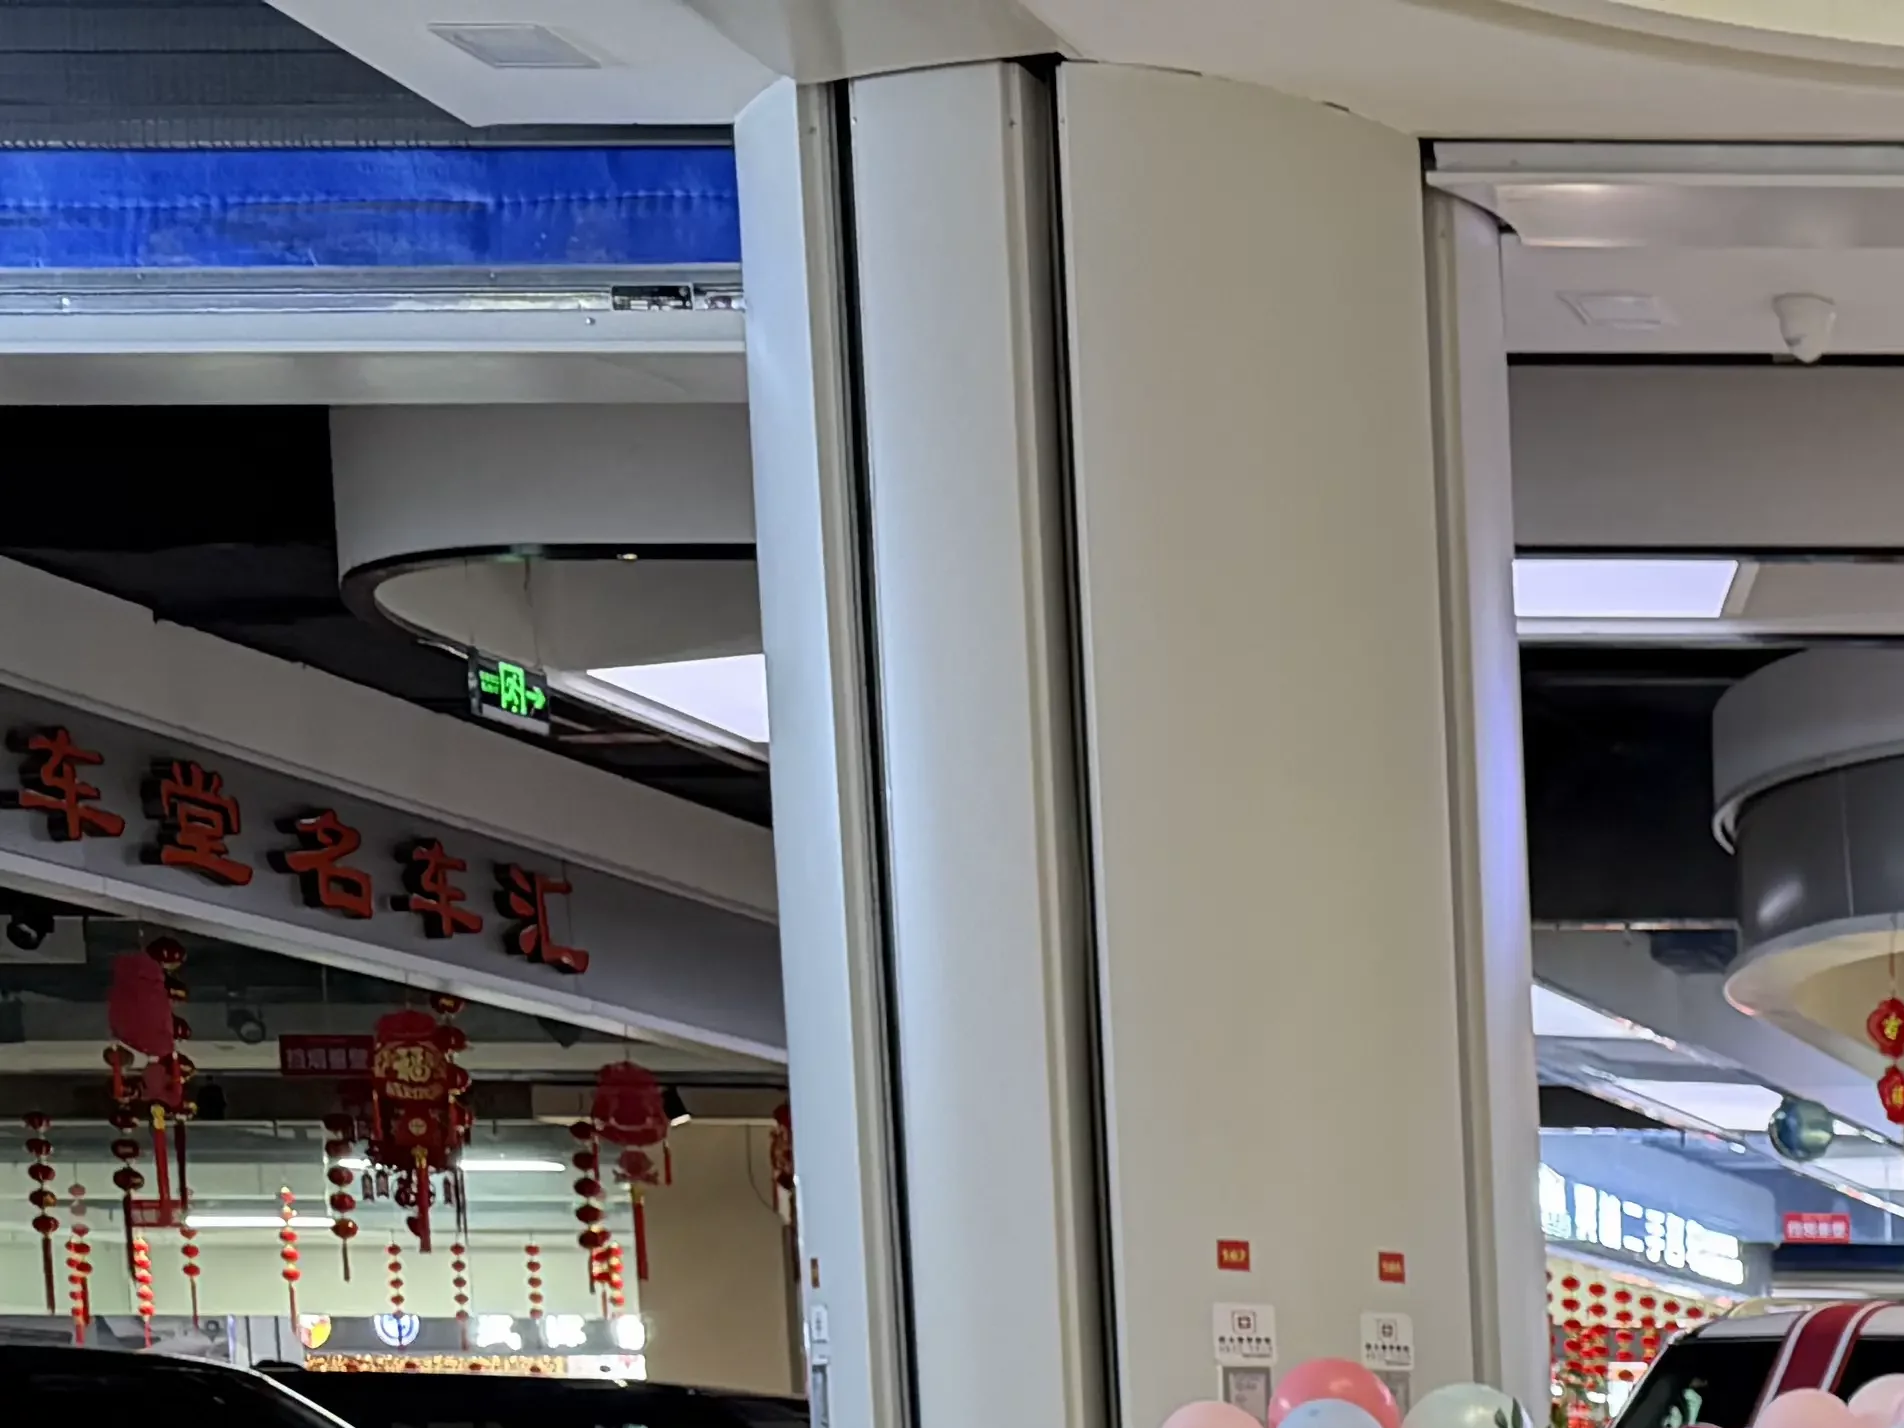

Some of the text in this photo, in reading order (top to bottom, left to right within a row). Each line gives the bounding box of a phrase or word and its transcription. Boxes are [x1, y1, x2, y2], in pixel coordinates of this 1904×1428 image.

[20, 728, 589, 974] 车堂名车汇
